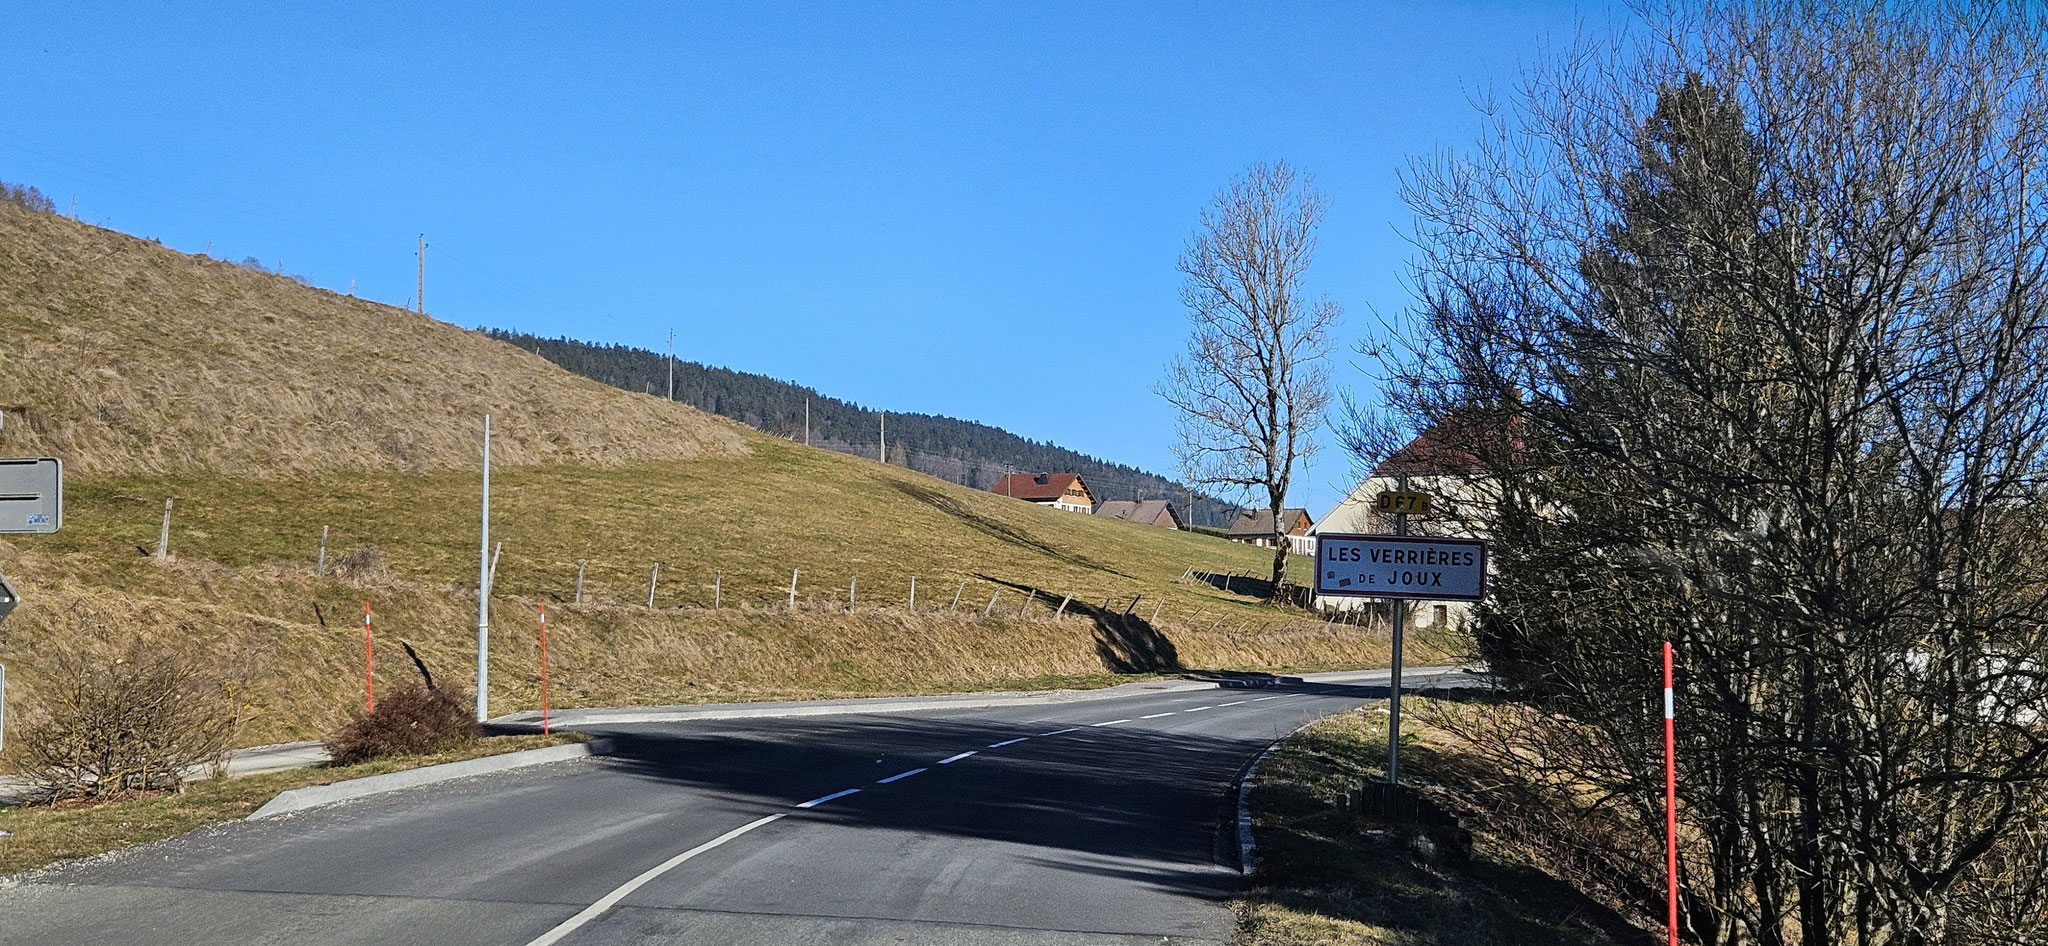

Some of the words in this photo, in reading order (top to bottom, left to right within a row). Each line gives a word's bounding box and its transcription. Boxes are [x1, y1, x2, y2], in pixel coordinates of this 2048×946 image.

[1328, 546, 1361, 562] LES
[1369, 547, 1474, 567] VERRIÈRES
[1358, 573, 1376, 584] DE
[1387, 570, 1443, 587] JOUX
